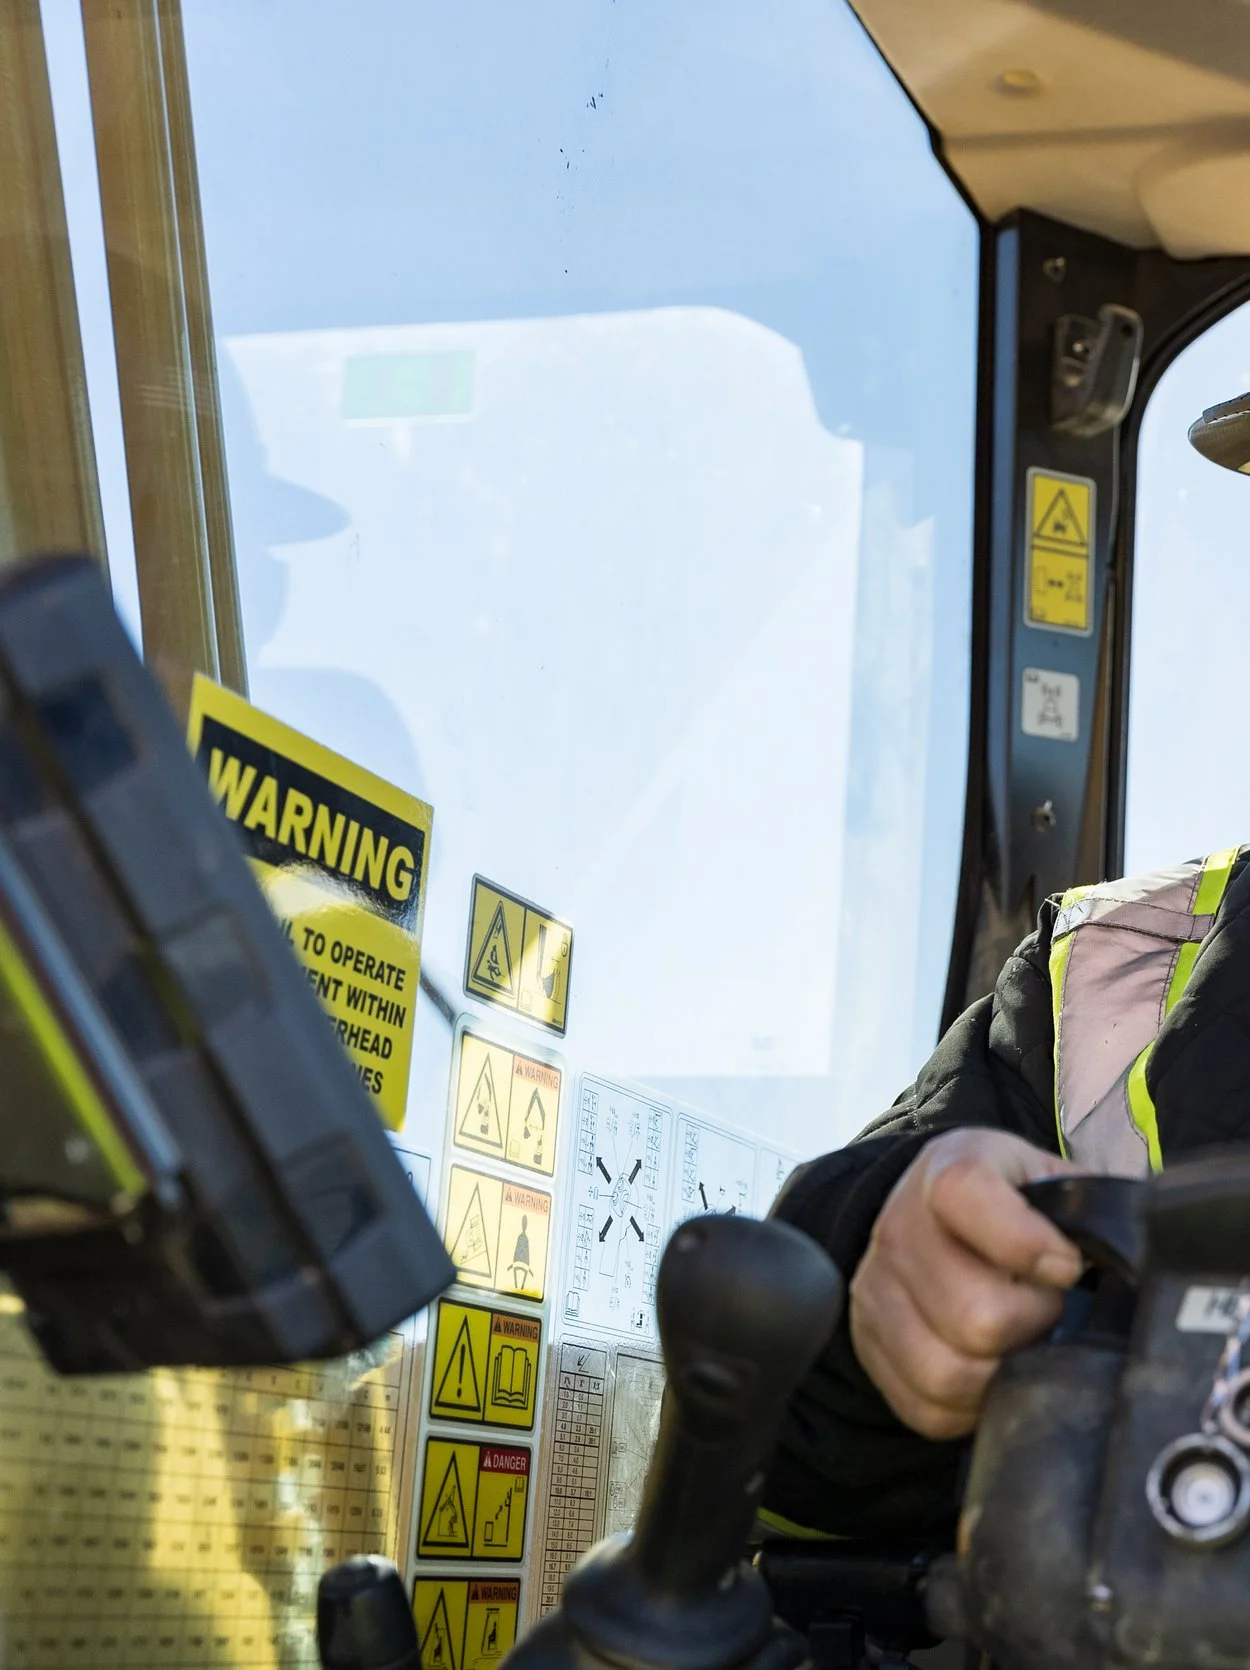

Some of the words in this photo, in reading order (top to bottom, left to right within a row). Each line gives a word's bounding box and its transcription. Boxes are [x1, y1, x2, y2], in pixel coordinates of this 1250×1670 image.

[208, 747, 415, 902] WARNING
[303, 926, 326, 957] TO
[330, 940, 407, 992] OPERATE
[346, 984, 407, 1029] WITHIN
[524, 1065, 559, 1090] WARNING
[514, 1190, 549, 1213] WARNING
[502, 1320, 538, 1341] WARNING
[492, 1453, 527, 1471] DANGER
[481, 1586, 517, 1601] WARNING
